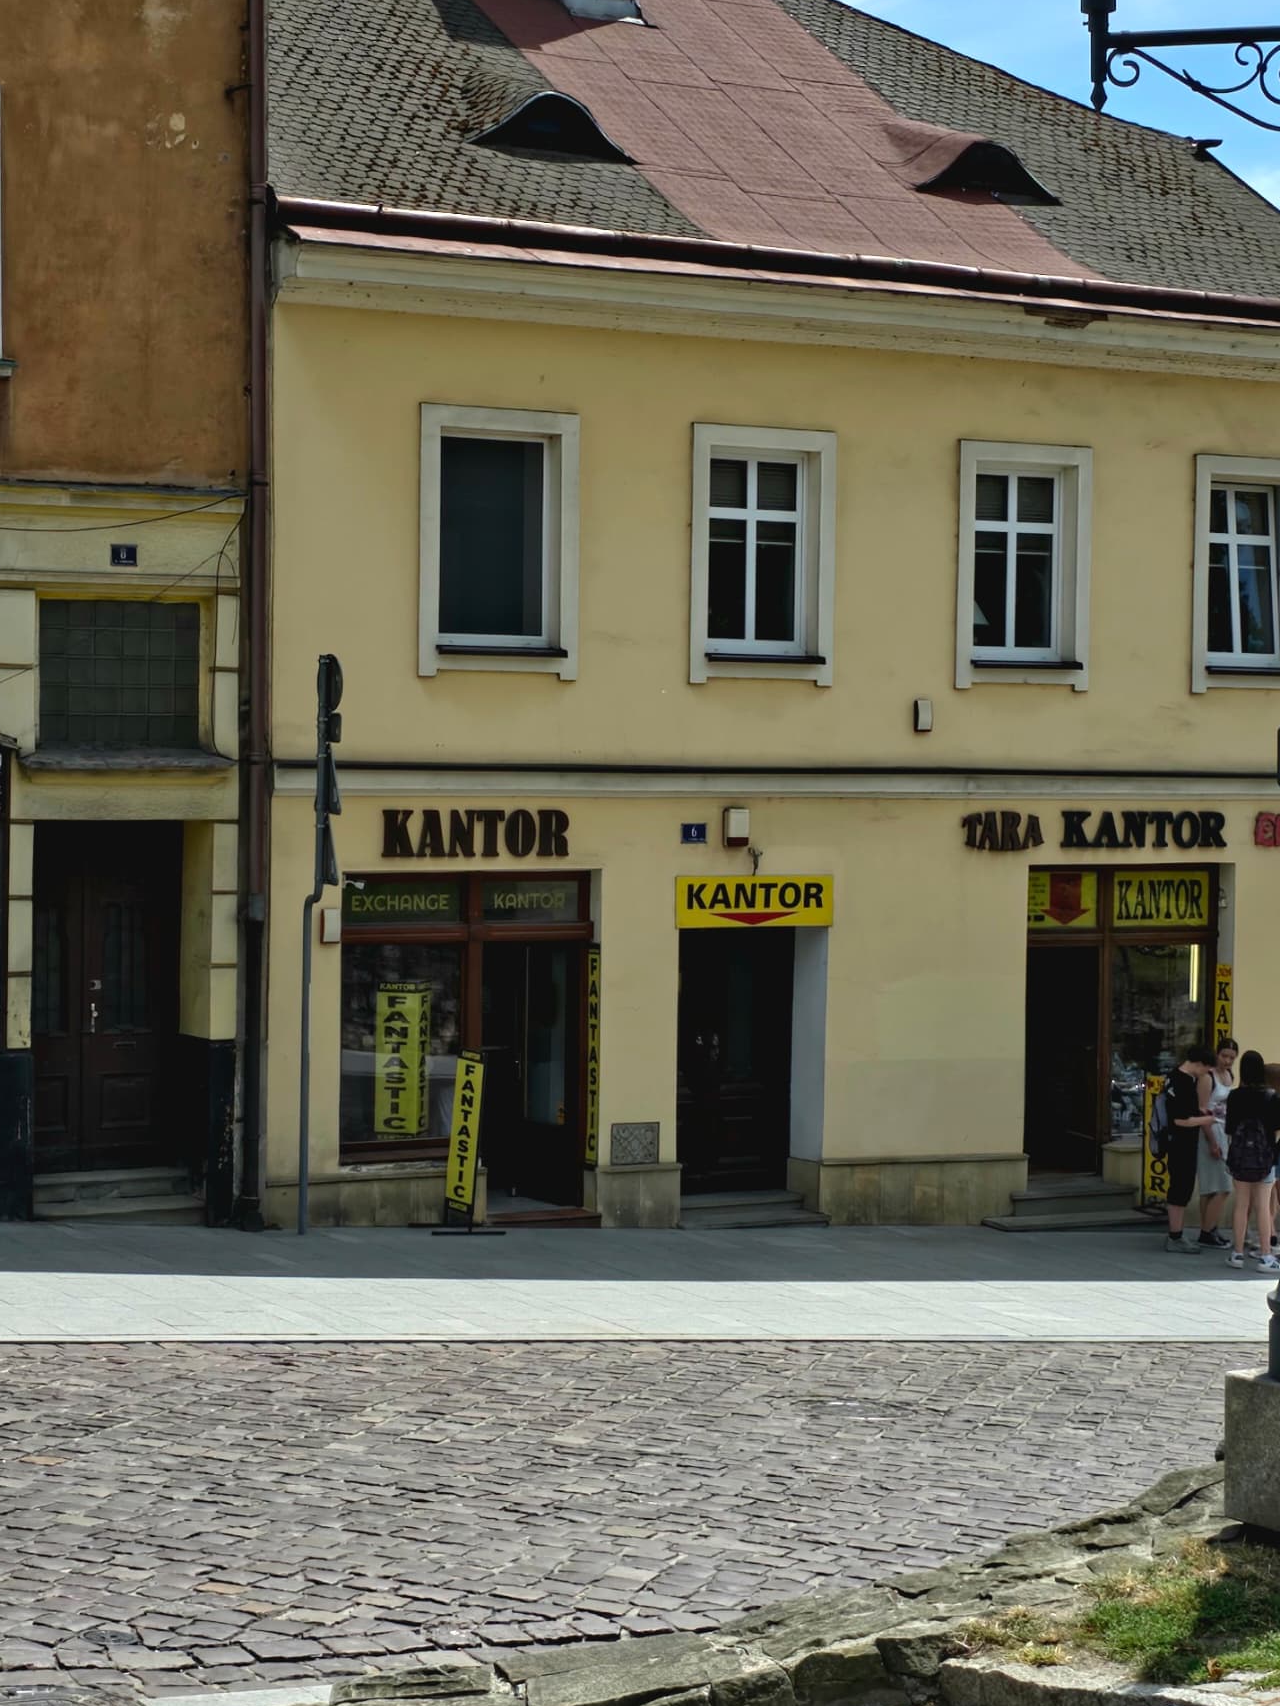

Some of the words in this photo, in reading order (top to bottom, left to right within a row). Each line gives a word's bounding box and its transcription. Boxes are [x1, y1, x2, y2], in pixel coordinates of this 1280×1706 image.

[381, 809, 569, 857] KANTOR
[691, 824, 698, 838] 6
[962, 811, 1045, 851] TARA
[1060, 811, 1227, 848] KANTOR
[351, 893, 450, 912] EXCHANGE
[494, 893, 566, 910] KANTOR
[687, 882, 824, 910] KANTOR
[1115, 879, 1204, 920] KANTOR
[383, 995, 410, 1130] FANTASTIC
[587, 958, 598, 1151] FANTASTIC
[453, 1063, 476, 1198] FANTASTIC
